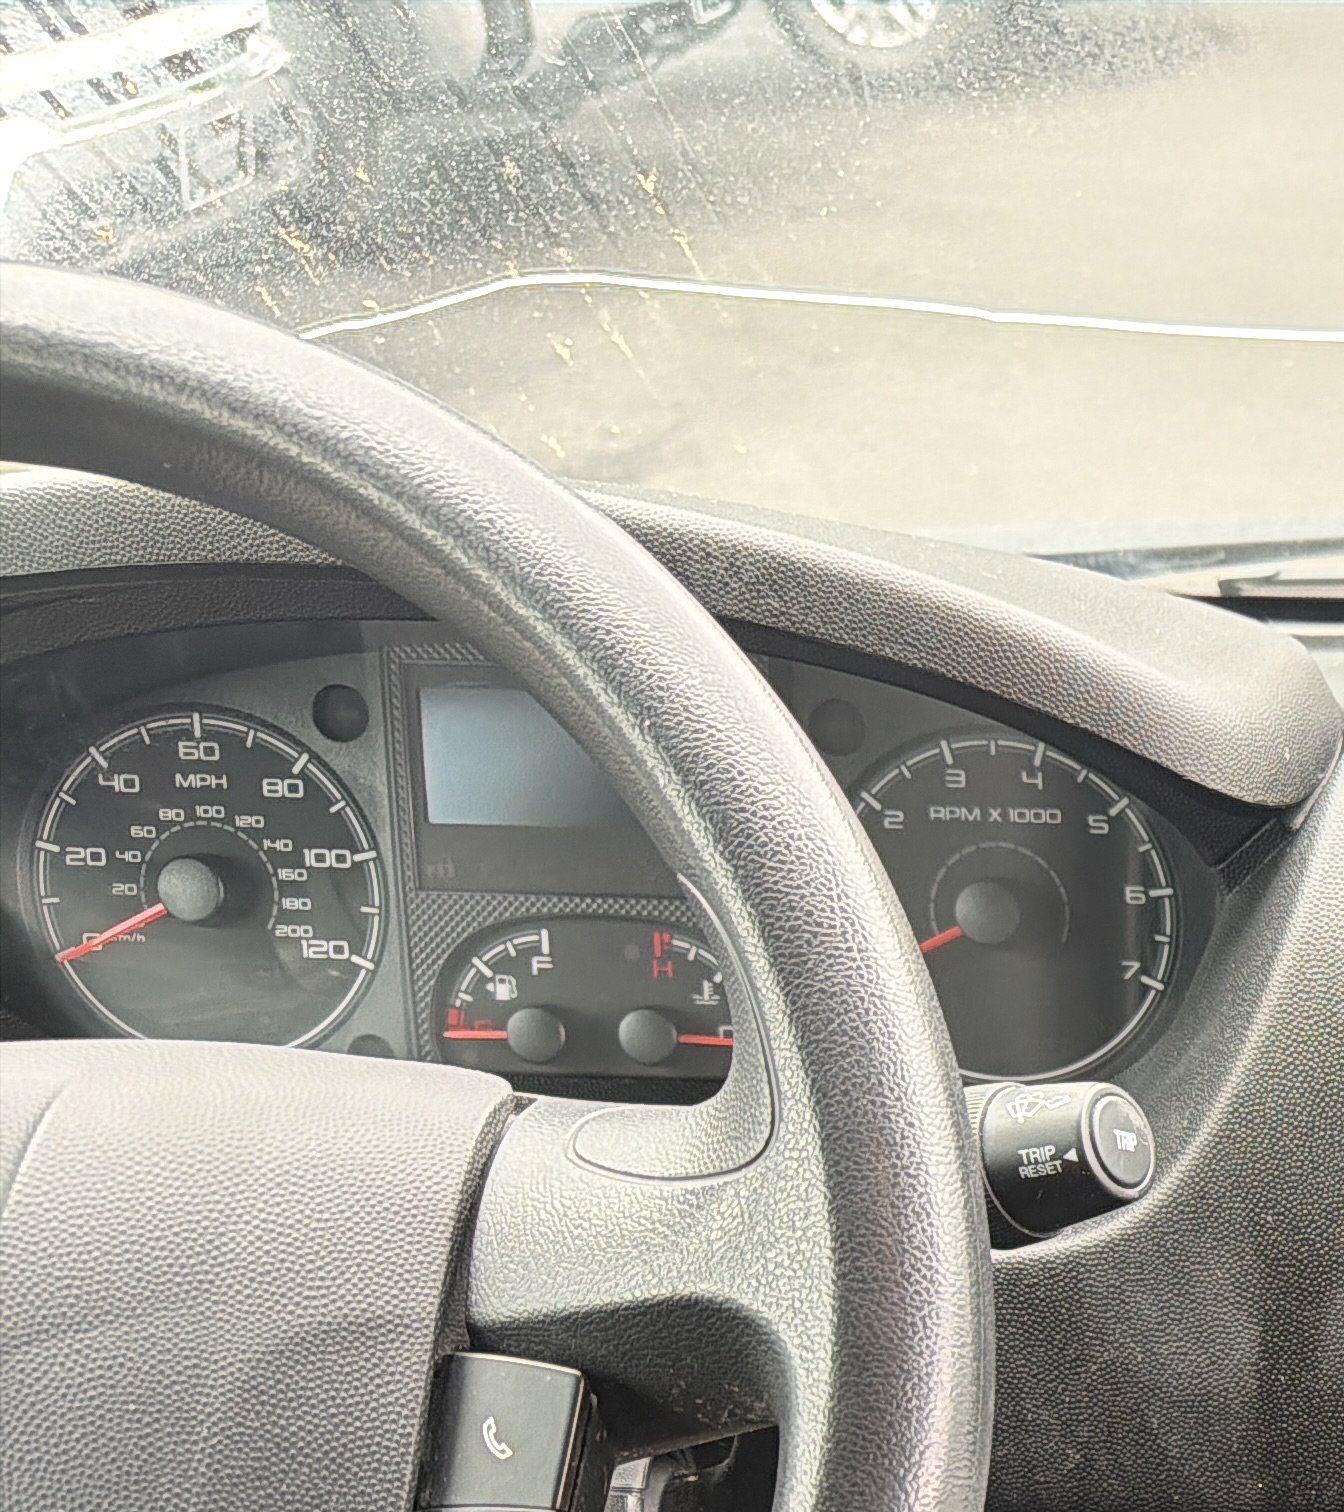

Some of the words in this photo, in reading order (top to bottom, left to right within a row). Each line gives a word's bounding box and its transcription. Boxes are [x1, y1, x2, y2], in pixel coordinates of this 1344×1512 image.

[178, 742, 220, 761] 60
[99, 774, 140, 793] 40
[175, 773, 228, 790] MPH
[946, 770, 967, 788] 3
[1021, 770, 1044, 790] 4
[262, 779, 304, 799] 80
[159, 808, 185, 822] 80
[195, 805, 225, 818] 100
[883, 811, 905, 829] 2
[929, 806, 983, 823] RPM
[989, 807, 1002, 823] X
[1008, 807, 1062, 824] 1000
[235, 815, 265, 828] 120
[1088, 816, 1109, 835] 5
[131, 826, 156, 839] 60
[263, 839, 293, 852] 140
[65, 847, 107, 867] 20
[116, 851, 142, 863] 40
[303, 849, 352, 869] 100
[278, 869, 307, 882] 160
[112, 884, 138, 896] 20
[1125, 886, 1146, 904] 6
[282, 898, 312, 911] 180
[275, 925, 313, 938] 200
[301, 940, 349, 960] 120
[531, 956, 554, 975] F
[653, 960, 673, 978] H
[1121, 961, 1141, 980] 7
[1113, 1129, 1138, 1153] TRIP
[1018, 1145, 1057, 1166] TRIP
[1019, 1159, 1064, 1179] RESET
